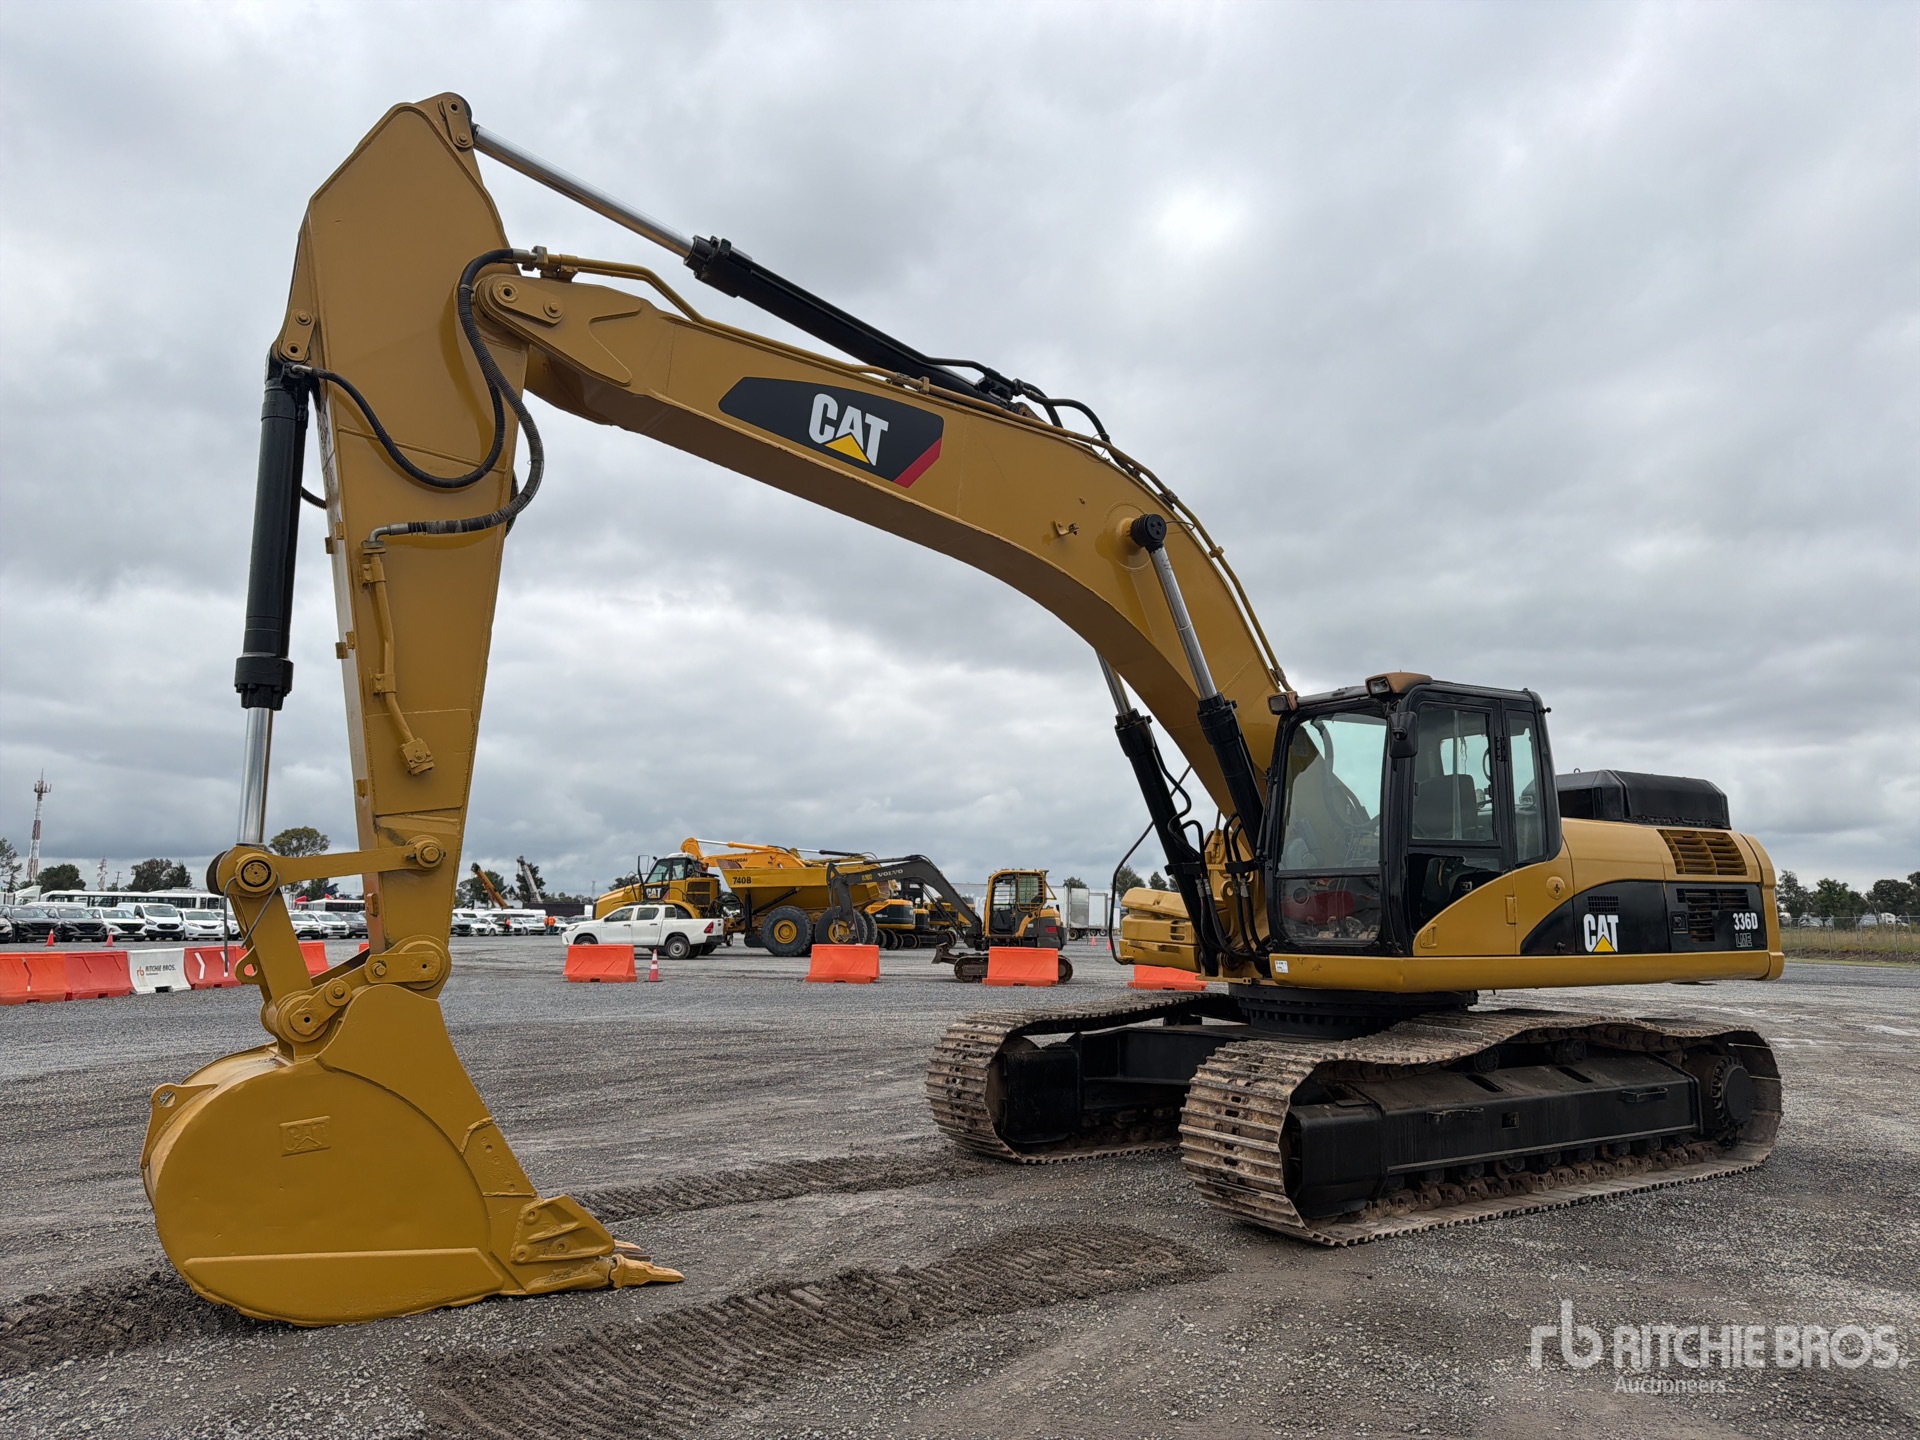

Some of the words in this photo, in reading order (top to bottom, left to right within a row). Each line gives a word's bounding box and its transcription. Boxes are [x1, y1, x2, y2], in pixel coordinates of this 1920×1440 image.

[809, 393, 889, 466] CAT
[733, 876, 752, 885] 740B
[877, 868, 904, 878] VOLVO
[646, 888, 662, 899] CAT
[1732, 912, 1759, 930] 336D
[1583, 913, 1619, 952] CAT
[285, 1122, 327, 1150] CAT
